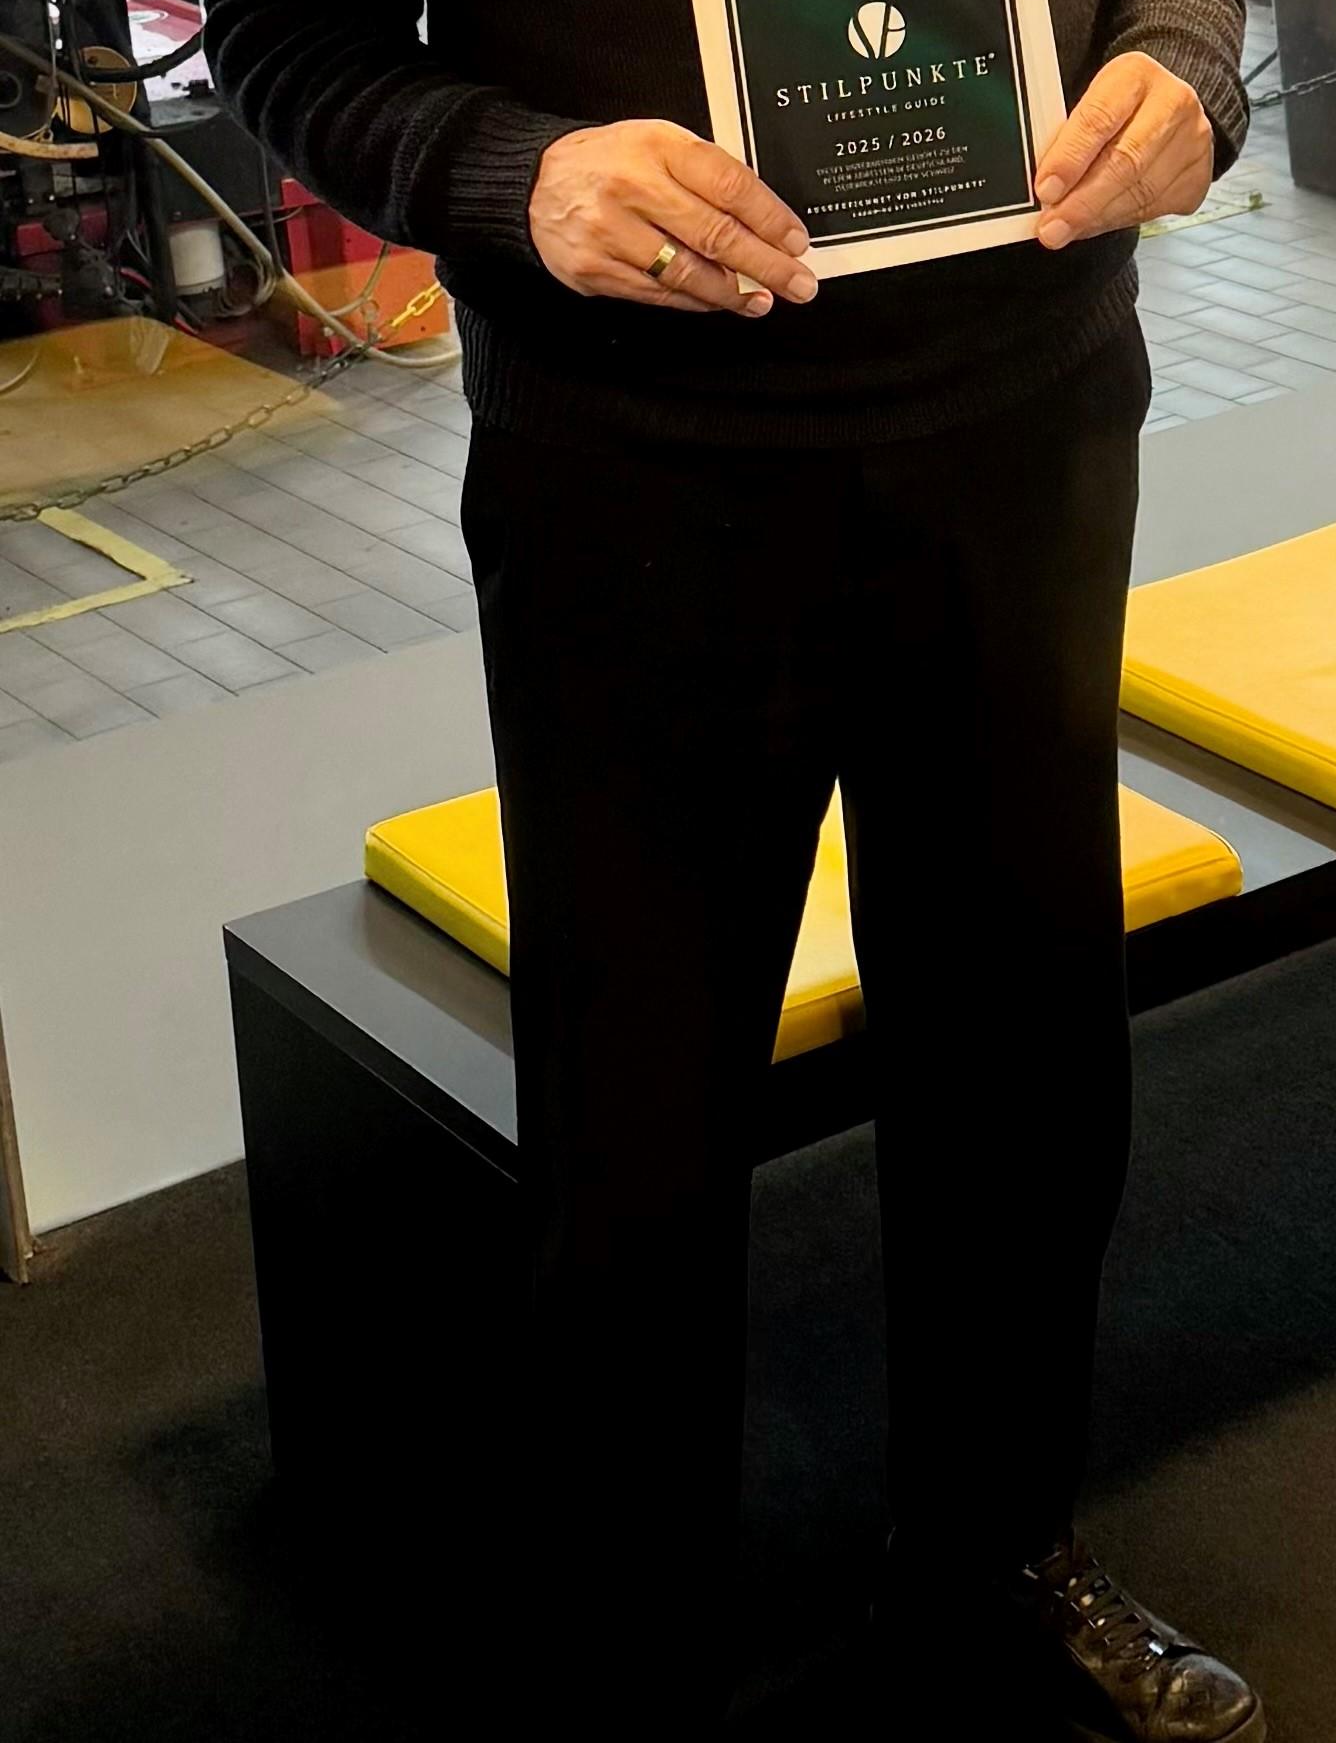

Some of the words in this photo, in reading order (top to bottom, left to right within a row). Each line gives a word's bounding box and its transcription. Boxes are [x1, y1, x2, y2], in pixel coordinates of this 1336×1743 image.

[905, 95, 946, 110] GUIDE
[835, 137, 880, 156] 2025
[902, 126, 946, 146] 2026
